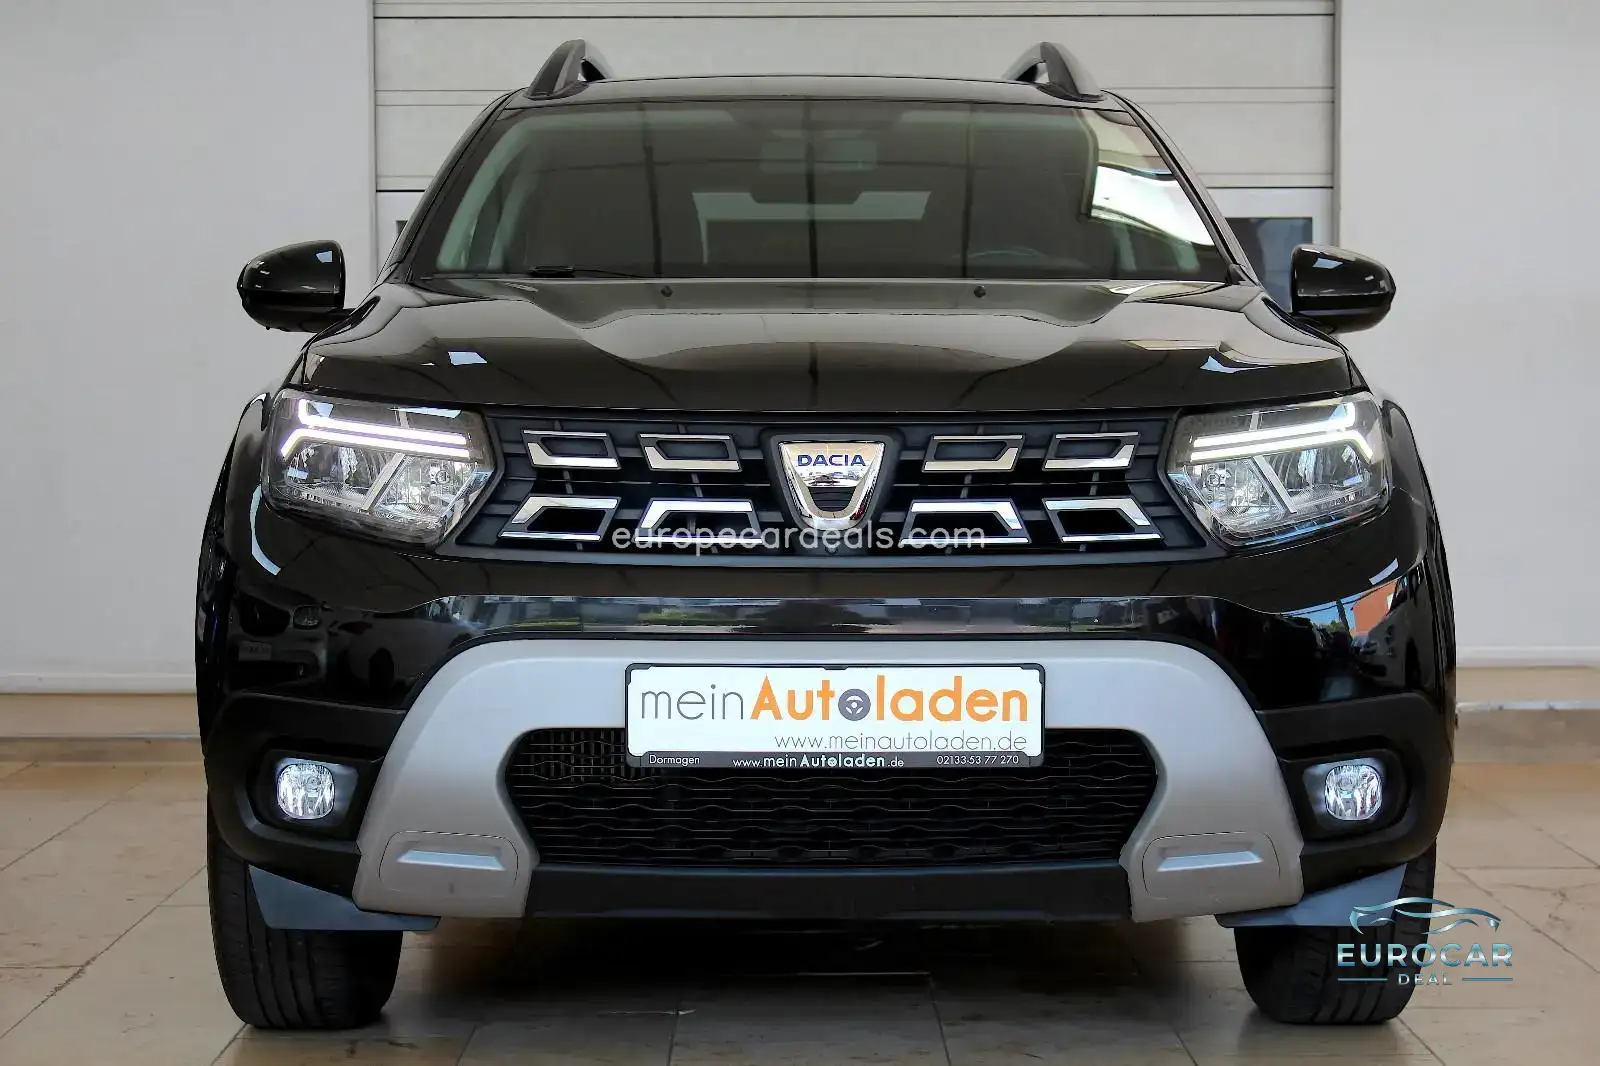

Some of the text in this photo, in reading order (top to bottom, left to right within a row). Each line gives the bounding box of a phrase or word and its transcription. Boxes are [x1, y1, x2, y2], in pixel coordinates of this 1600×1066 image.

[797, 454, 866, 467] DACIA
[774, 730, 1027, 750] www.meinautoladen.de
[649, 755, 700, 766] Dormagen
[984, 755, 997, 765] 77
[1000, 755, 1019, 765] 270
